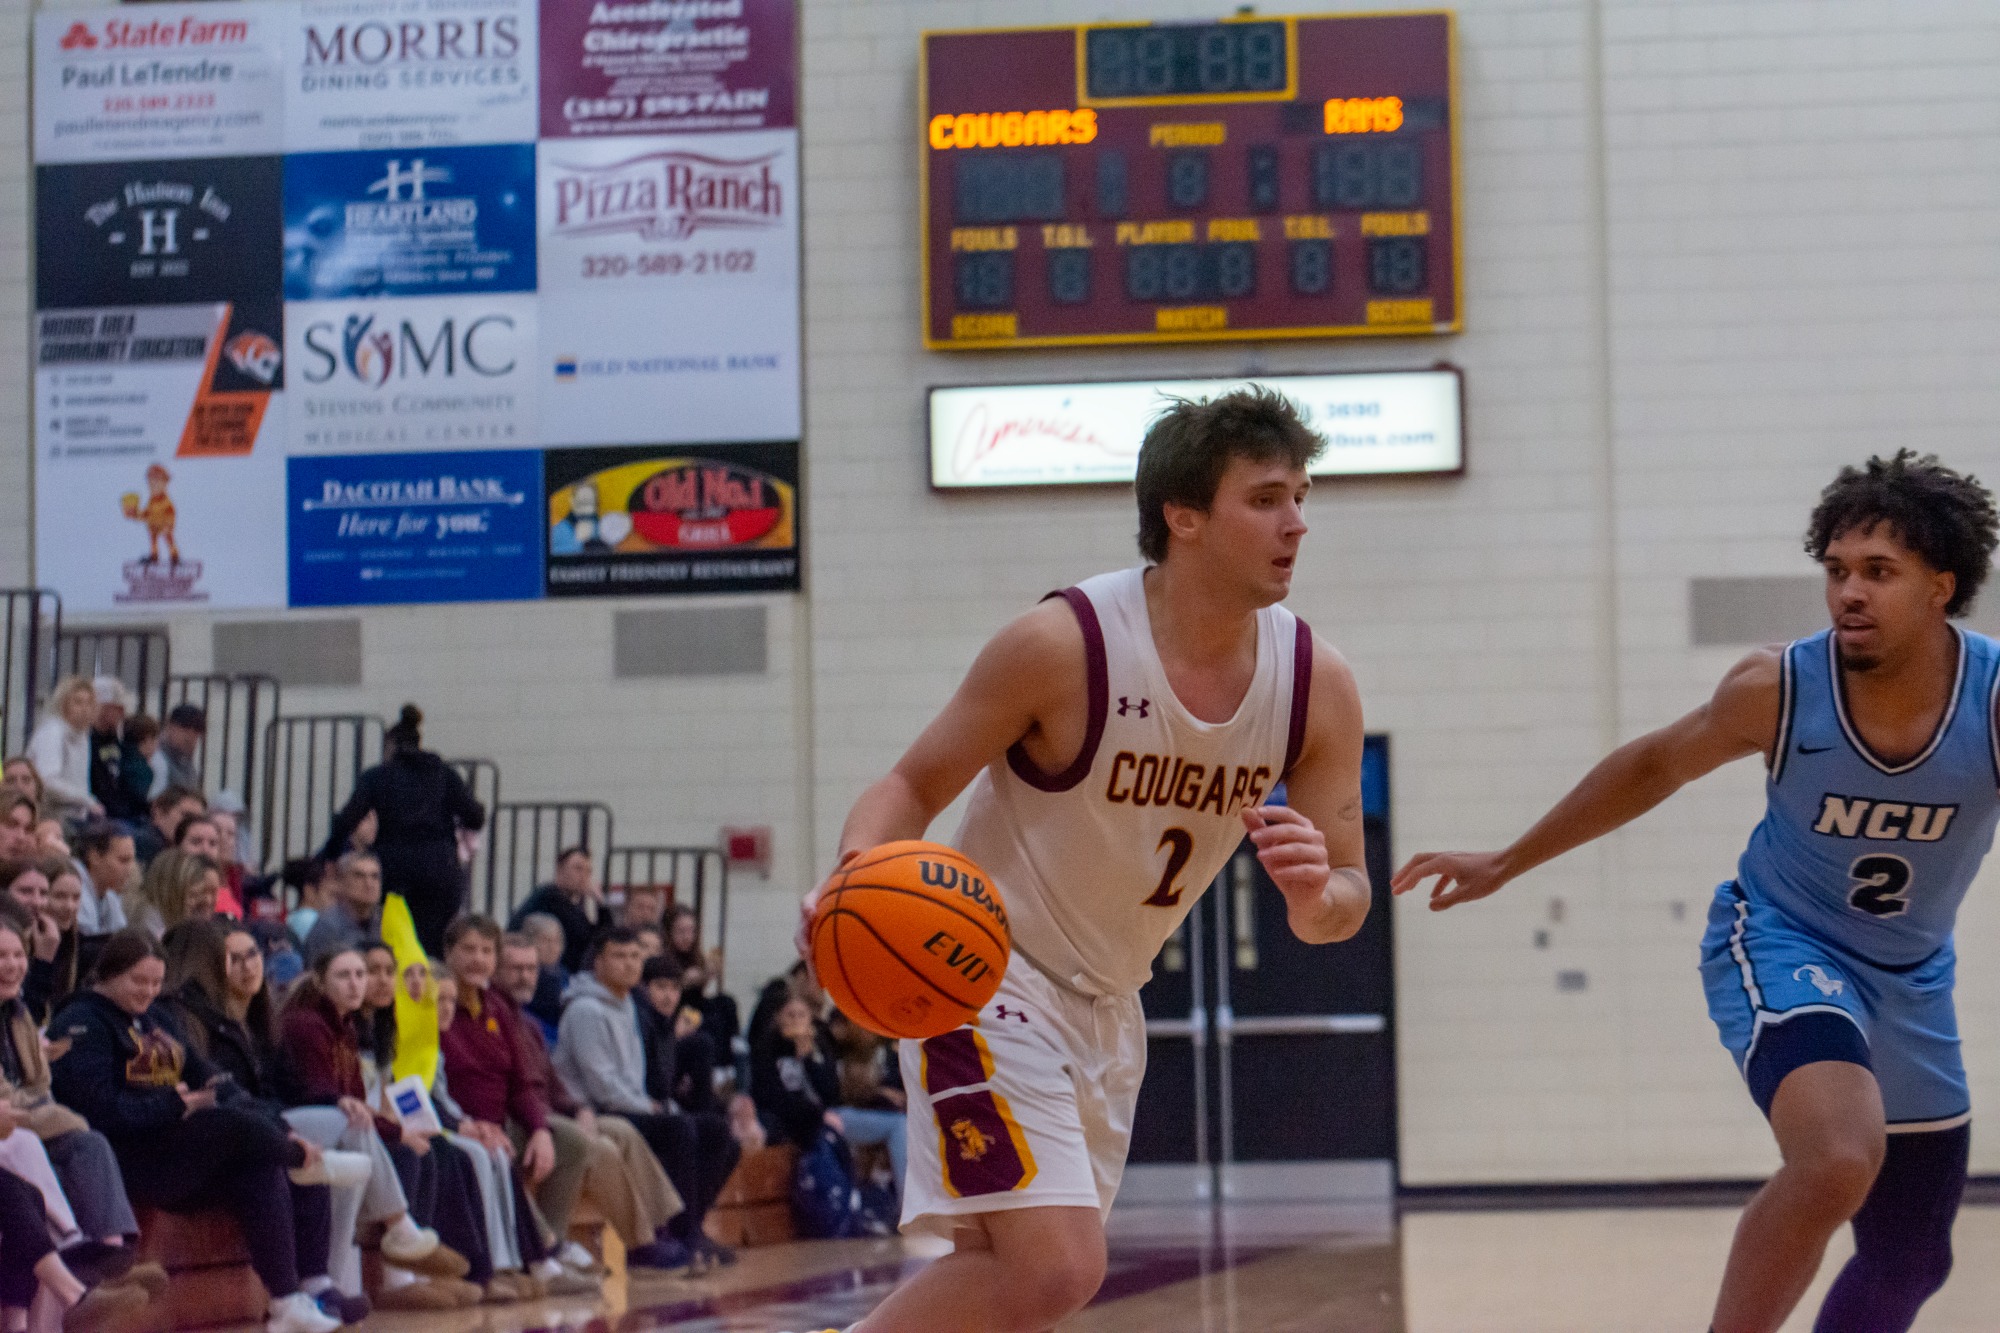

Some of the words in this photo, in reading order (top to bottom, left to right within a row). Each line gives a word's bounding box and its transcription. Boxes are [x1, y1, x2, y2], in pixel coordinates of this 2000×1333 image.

[303, 16, 520, 66] MORRIS
[583, 26, 749, 53] Chiropractic
[62, 64, 114, 88] Paul
[121, 58, 233, 86] LeTendre
[302, 74, 389, 92] DINING
[401, 67, 520, 87] SERVICES
[929, 108, 1098, 149] COUGARS
[1324, 96, 1404, 134] RAMS
[556, 177, 657, 224] Pizza
[667, 164, 783, 216] Ranch
[345, 199, 478, 228] HEARTLAND
[1361, 212, 1429, 236] FOULS
[138, 208, 180, 254] H
[951, 226, 1017, 251] FOULS
[582, 250, 755, 277] 320-589-2102
[627, 357, 719, 375] NATIONAL
[727, 354, 778, 371] BANK
[323, 479, 433, 502] DACOTAH
[439, 476, 503, 500] BANK
[643, 470, 698, 510] Old
[338, 512, 392, 537] Here
[395, 512, 429, 540] for
[1106, 750, 1271, 816] COUGARS
[1811, 792, 1961, 841] NCU
[1141, 826, 1194, 907] 2
[1847, 853, 1913, 919] 2
